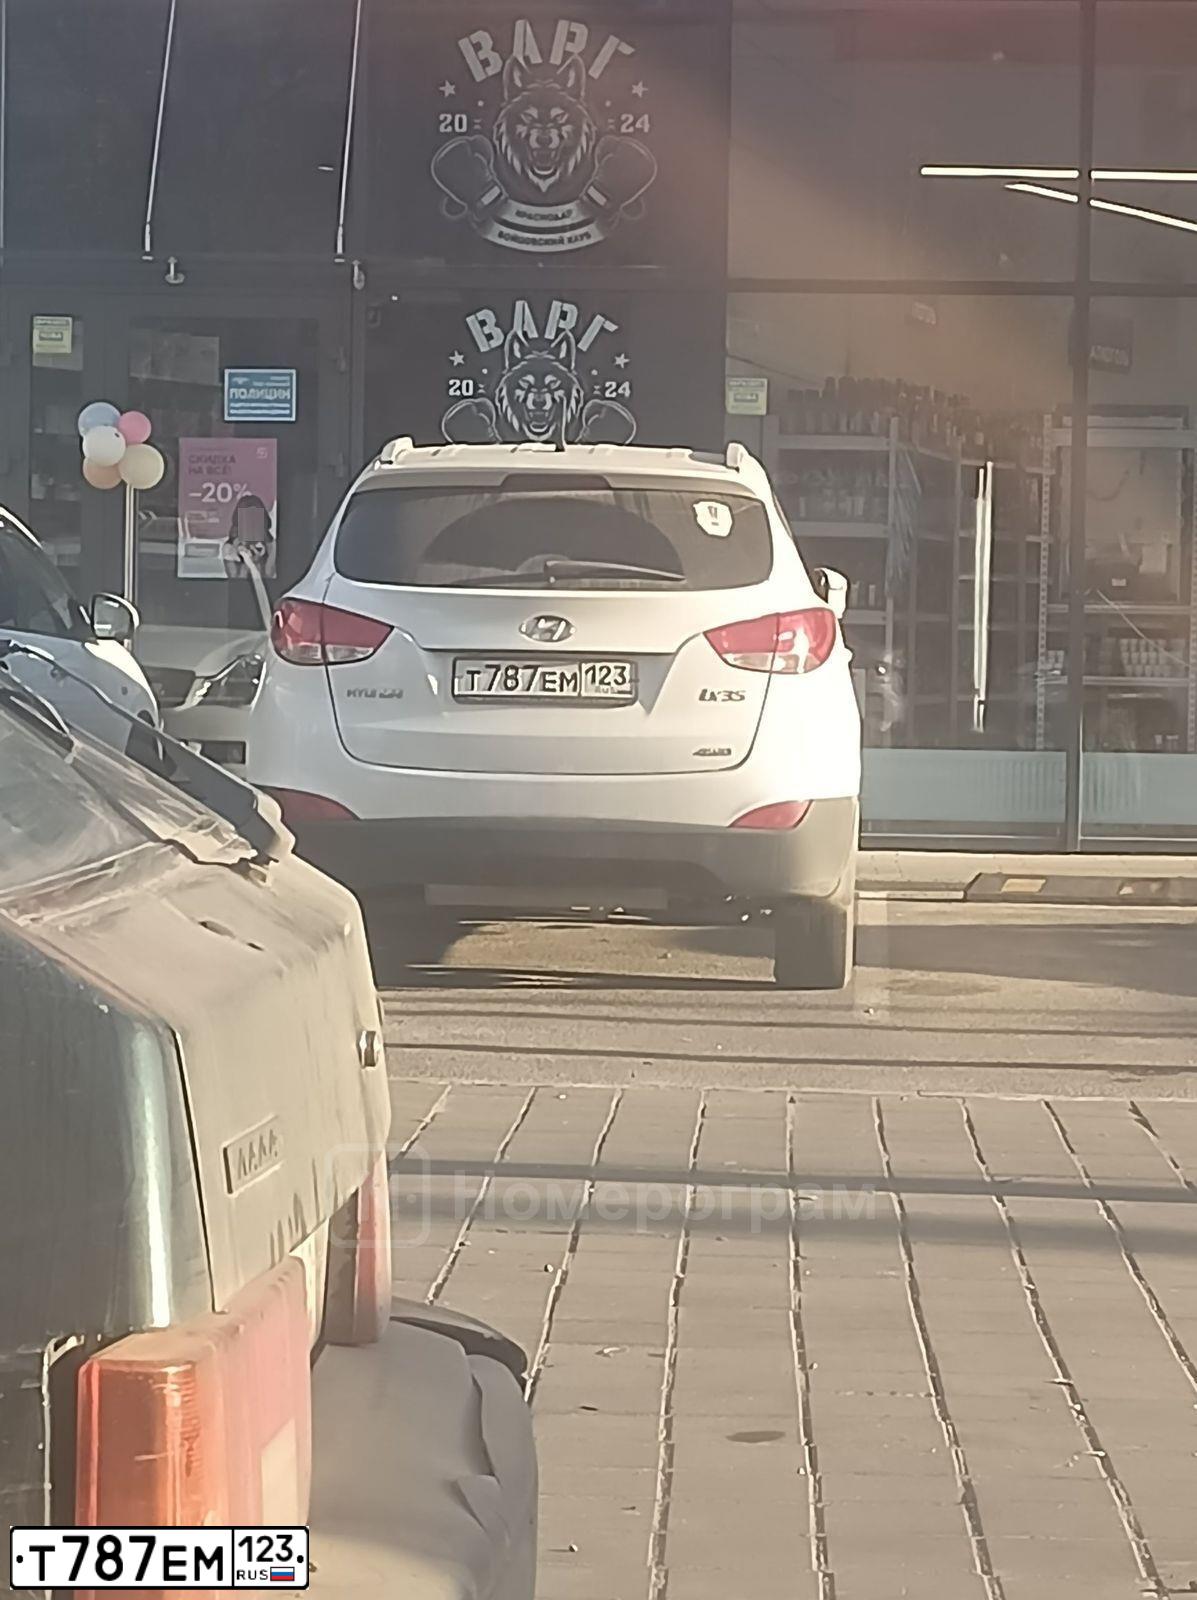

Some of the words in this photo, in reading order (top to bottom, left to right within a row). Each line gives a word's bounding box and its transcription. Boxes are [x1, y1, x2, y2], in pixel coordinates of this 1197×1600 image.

[457, 18, 636, 83] ВАРГ
[439, 113, 468, 133] 20
[620, 113, 650, 133] 24
[466, 300, 619, 353] ВАРГ
[448, 379, 474, 397] 20
[605, 381, 631, 398] 24
[466, 664, 578, 693] Т787ЕМ
[585, 665, 627, 686] 123
